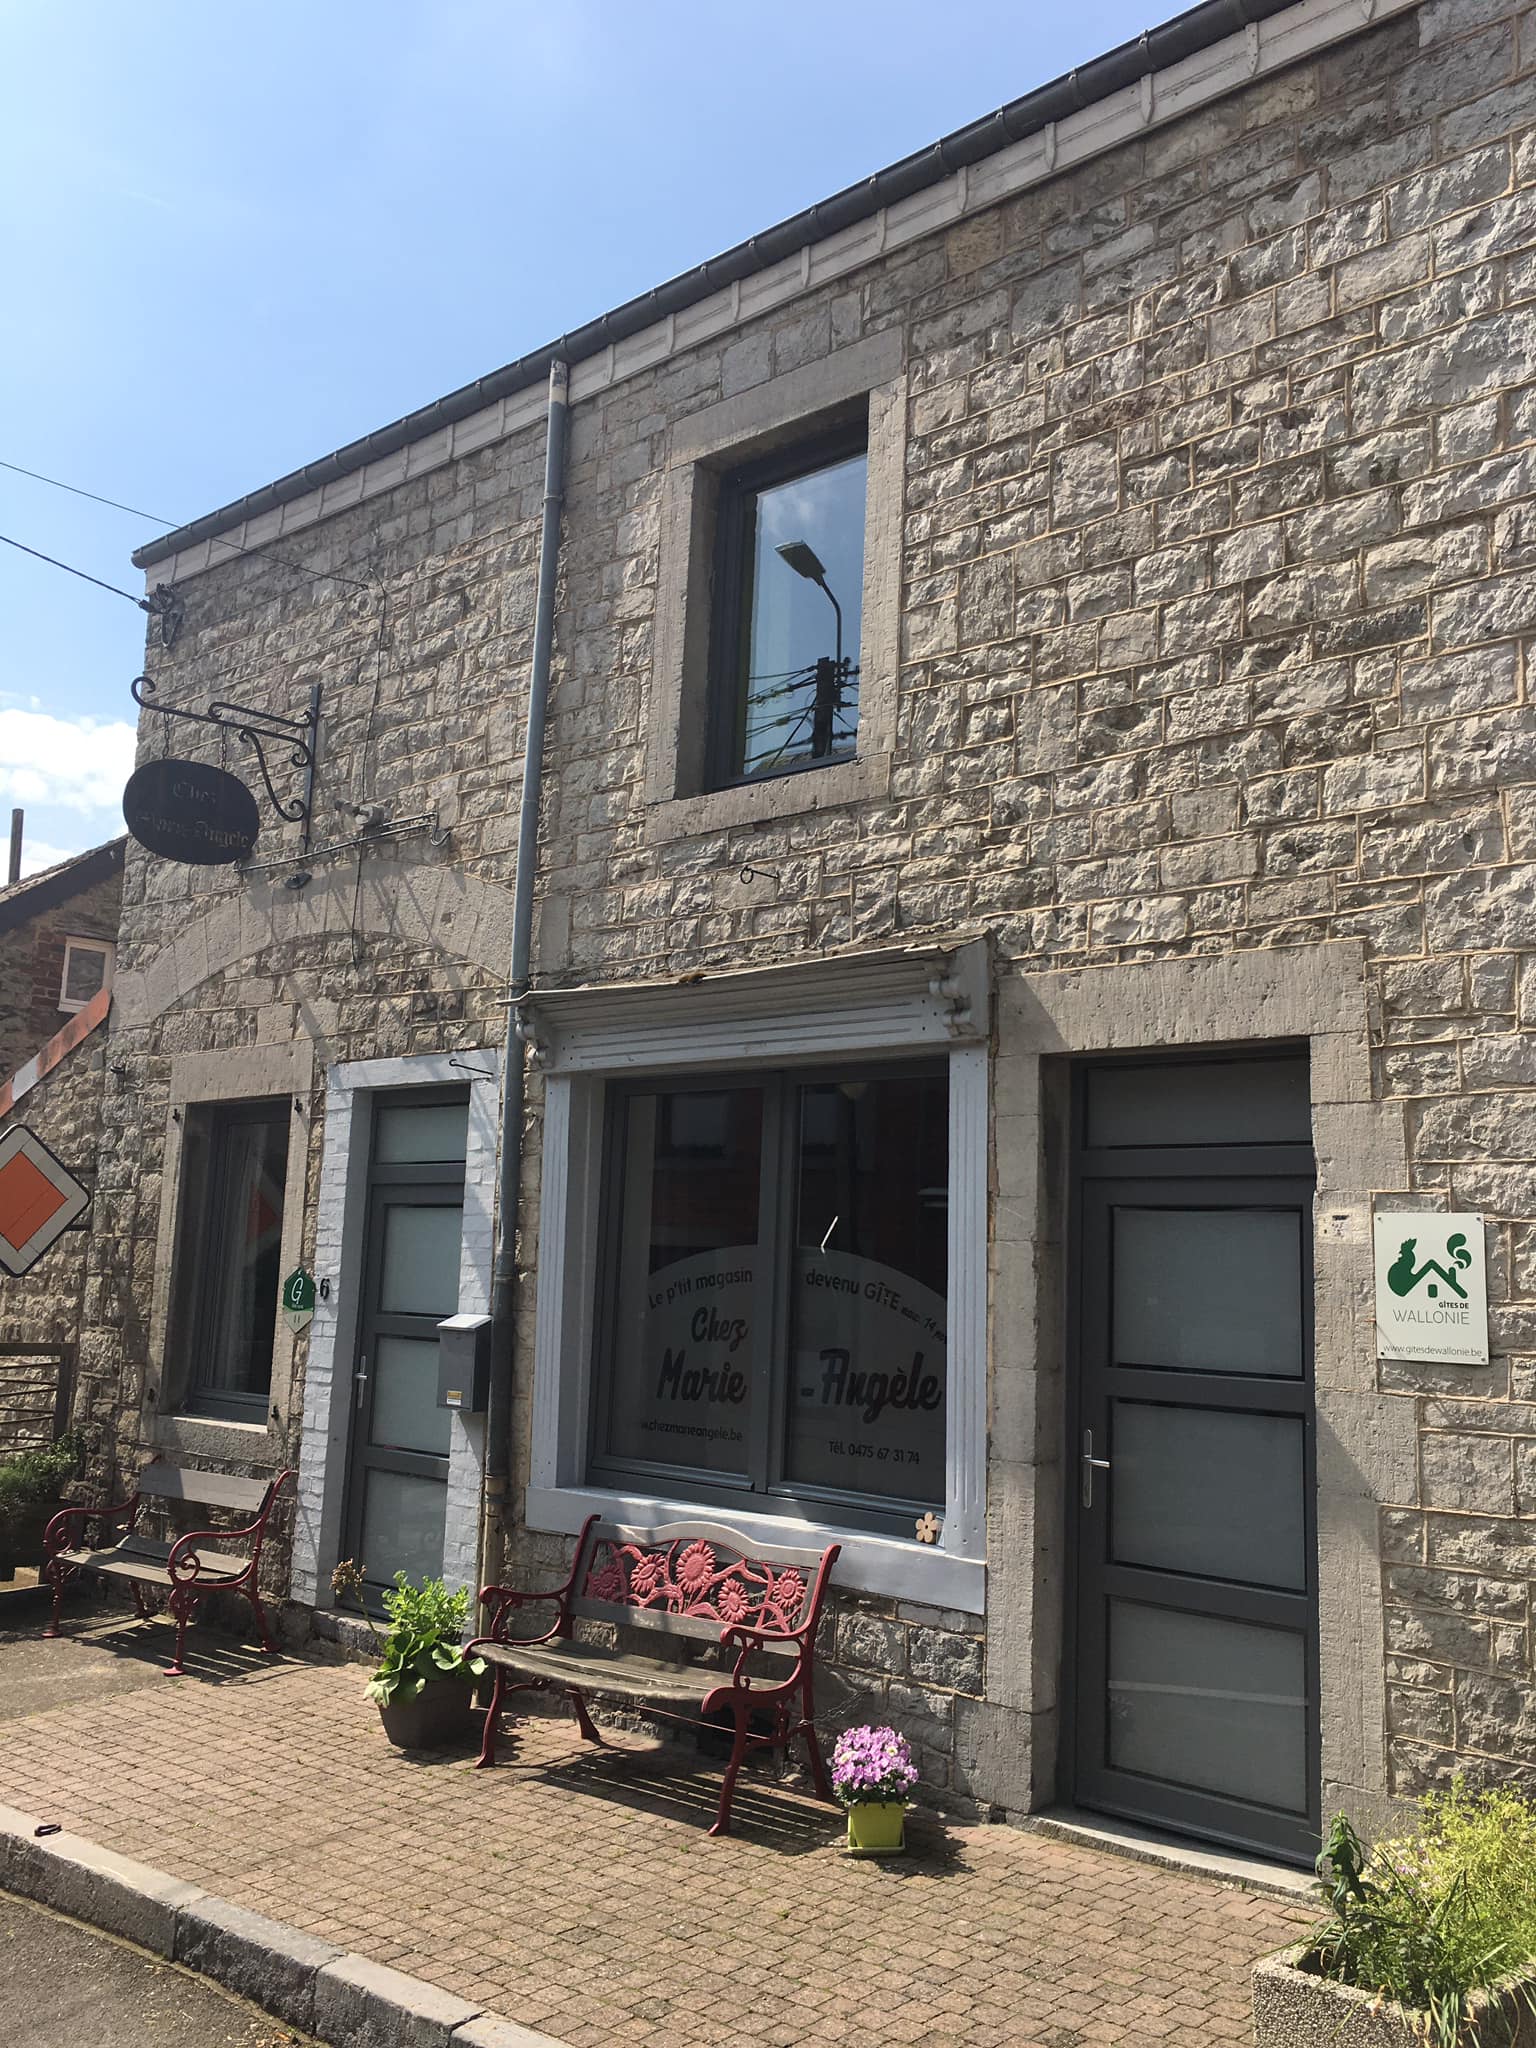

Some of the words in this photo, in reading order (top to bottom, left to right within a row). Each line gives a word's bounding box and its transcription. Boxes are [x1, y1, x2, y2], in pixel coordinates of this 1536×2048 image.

[291, 1277, 304, 1304] G
[320, 1277, 330, 1300] 6
[649, 1294, 664, 1309] Le
[667, 1278, 691, 1304] p'tit
[696, 1268, 753, 1290] magasin
[806, 1268, 860, 1295] devenu
[864, 1282, 901, 1310] GÎTE
[1393, 1309, 1470, 1325] WALLONIE
[1460, 1302, 1470, 1310] DE
[691, 1306, 748, 1352] Chez
[1383, 1345, 1483, 1358] www.gitesdewallonie.be
[656, 1347, 748, 1404] Marie
[848, 1443, 874, 1459] 0475
[876, 1447, 890, 1460] 67
[893, 1449, 904, 1462] 31
[907, 1450, 920, 1465] 74
